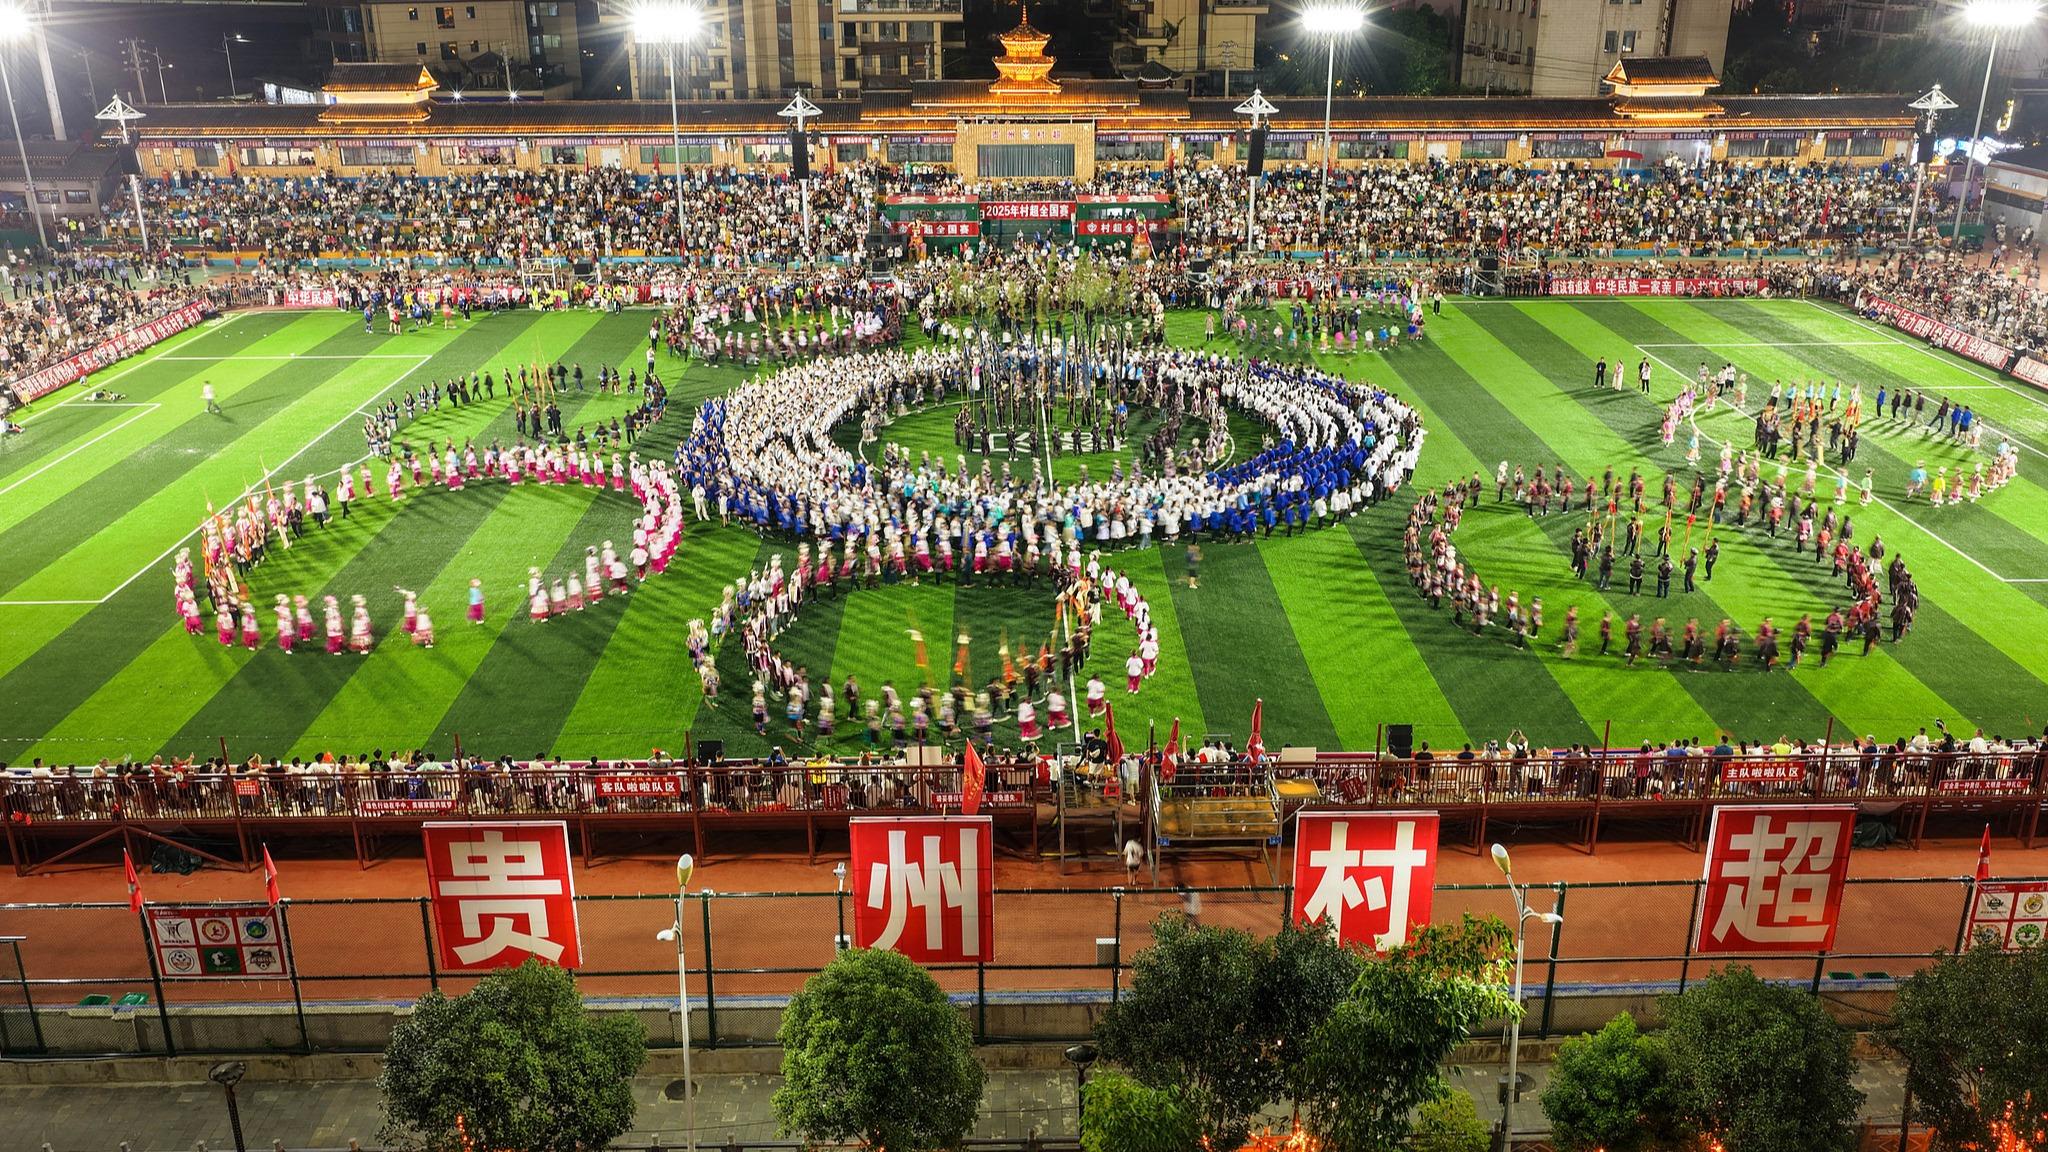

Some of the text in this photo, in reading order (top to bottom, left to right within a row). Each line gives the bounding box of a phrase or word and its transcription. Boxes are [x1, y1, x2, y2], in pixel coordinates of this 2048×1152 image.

[986, 204, 1069, 217] 2025年村超全国赛
[913, 224, 969, 235] 超全国赛
[1101, 223, 1158, 233] 村超全赛
[1596, 280, 1672, 294] 中华民族一家亲
[288, 289, 333, 305] 中华民族
[1726, 768, 1798, 778] 主队啦啦队区
[601, 782, 675, 793] 客队啦啦队区
[1712, 815, 1842, 943] 超
[867, 827, 979, 956] 州
[1304, 821, 1427, 952] 村
[438, 830, 565, 966] 贵
